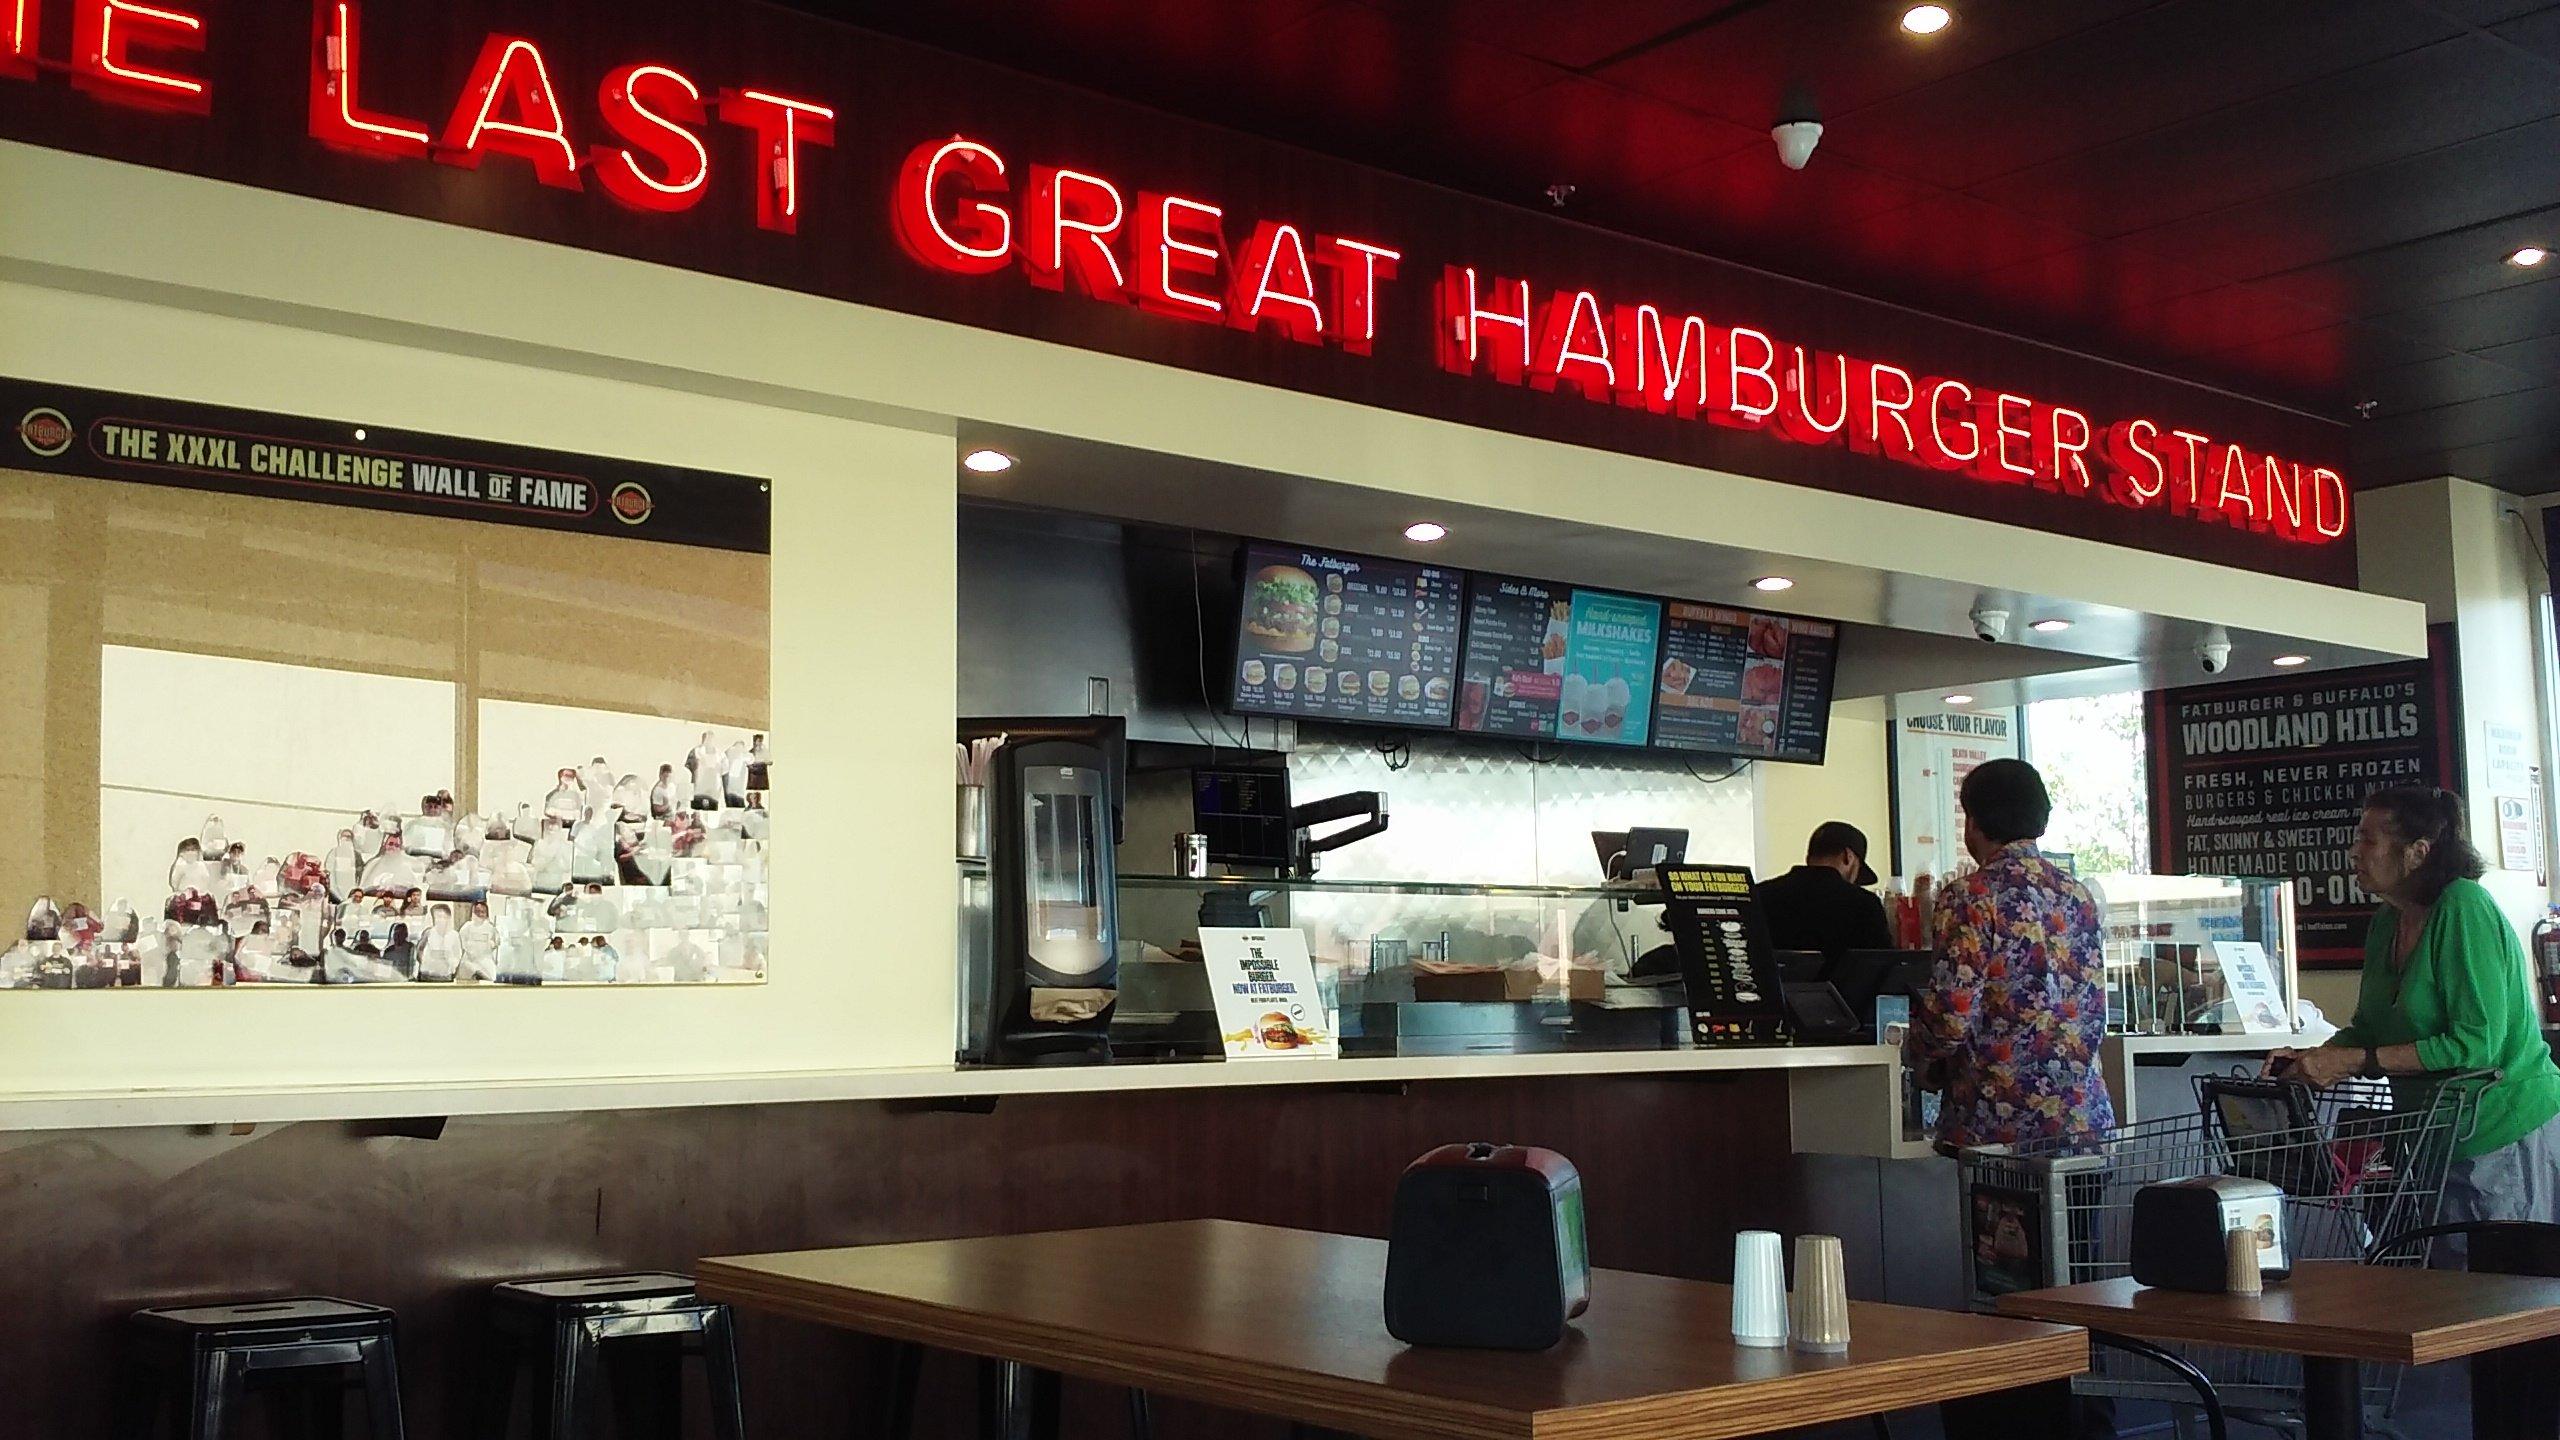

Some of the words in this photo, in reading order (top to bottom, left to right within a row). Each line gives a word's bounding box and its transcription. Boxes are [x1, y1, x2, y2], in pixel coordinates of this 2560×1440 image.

[310, 2, 836, 234] LAST
[893, 136, 1401, 357] GREAT
[1437, 264, 2092, 498] HAMBURGER
[2101, 416, 2350, 544] STAND
[102, 424, 157, 460] THE
[166, 432, 241, 471] XXXL
[250, 443, 404, 489] CHALLENGE
[412, 462, 480, 499] WALL
[488, 475, 513, 500] OF
[519, 477, 587, 512] FAME
[1499, 582, 1519, 595] Sides
[1528, 586, 1549, 599] More
[1577, 620, 1652, 643] MILKSHAKES
[2182, 696, 2284, 718] FATBURGER
[2312, 683, 2415, 705] BUFFALO'S
[1946, 714, 1971, 733] YOUR
[1973, 716, 2007, 738] FLAVOR
[2182, 711, 2329, 755] WOODLAND
[2336, 703, 2418, 742] HILLS
[2184, 771, 2254, 789] FRESH,
[2263, 765, 2328, 784] NEVER
[2338, 758, 2420, 778] FROZEN
[2185, 791, 2255, 810] BURGERS
[2265, 789, 2273, 805] &
[2282, 783, 2354, 804] CHICKEN
[2312, 808, 2351, 819] cream
[2214, 831, 2259, 851] SKINNY
[2264, 830, 2275, 848] &
[2277, 827, 2322, 847] SWEET
[2327, 825, 2361, 845] POTA
[2187, 853, 2288, 875] HOMEMADE
[1671, 881, 1684, 892] ON
[1682, 881, 1706, 892] YOUR
[1679, 871, 1701, 881] WHAT
[1711, 872, 1726, 881] YOU
[1250, 947, 1264, 959] THE
[1239, 959, 1279, 971] IMPOSSIBLE
[1232, 982, 1249, 994] NOW
[1250, 982, 1258, 994] AT
